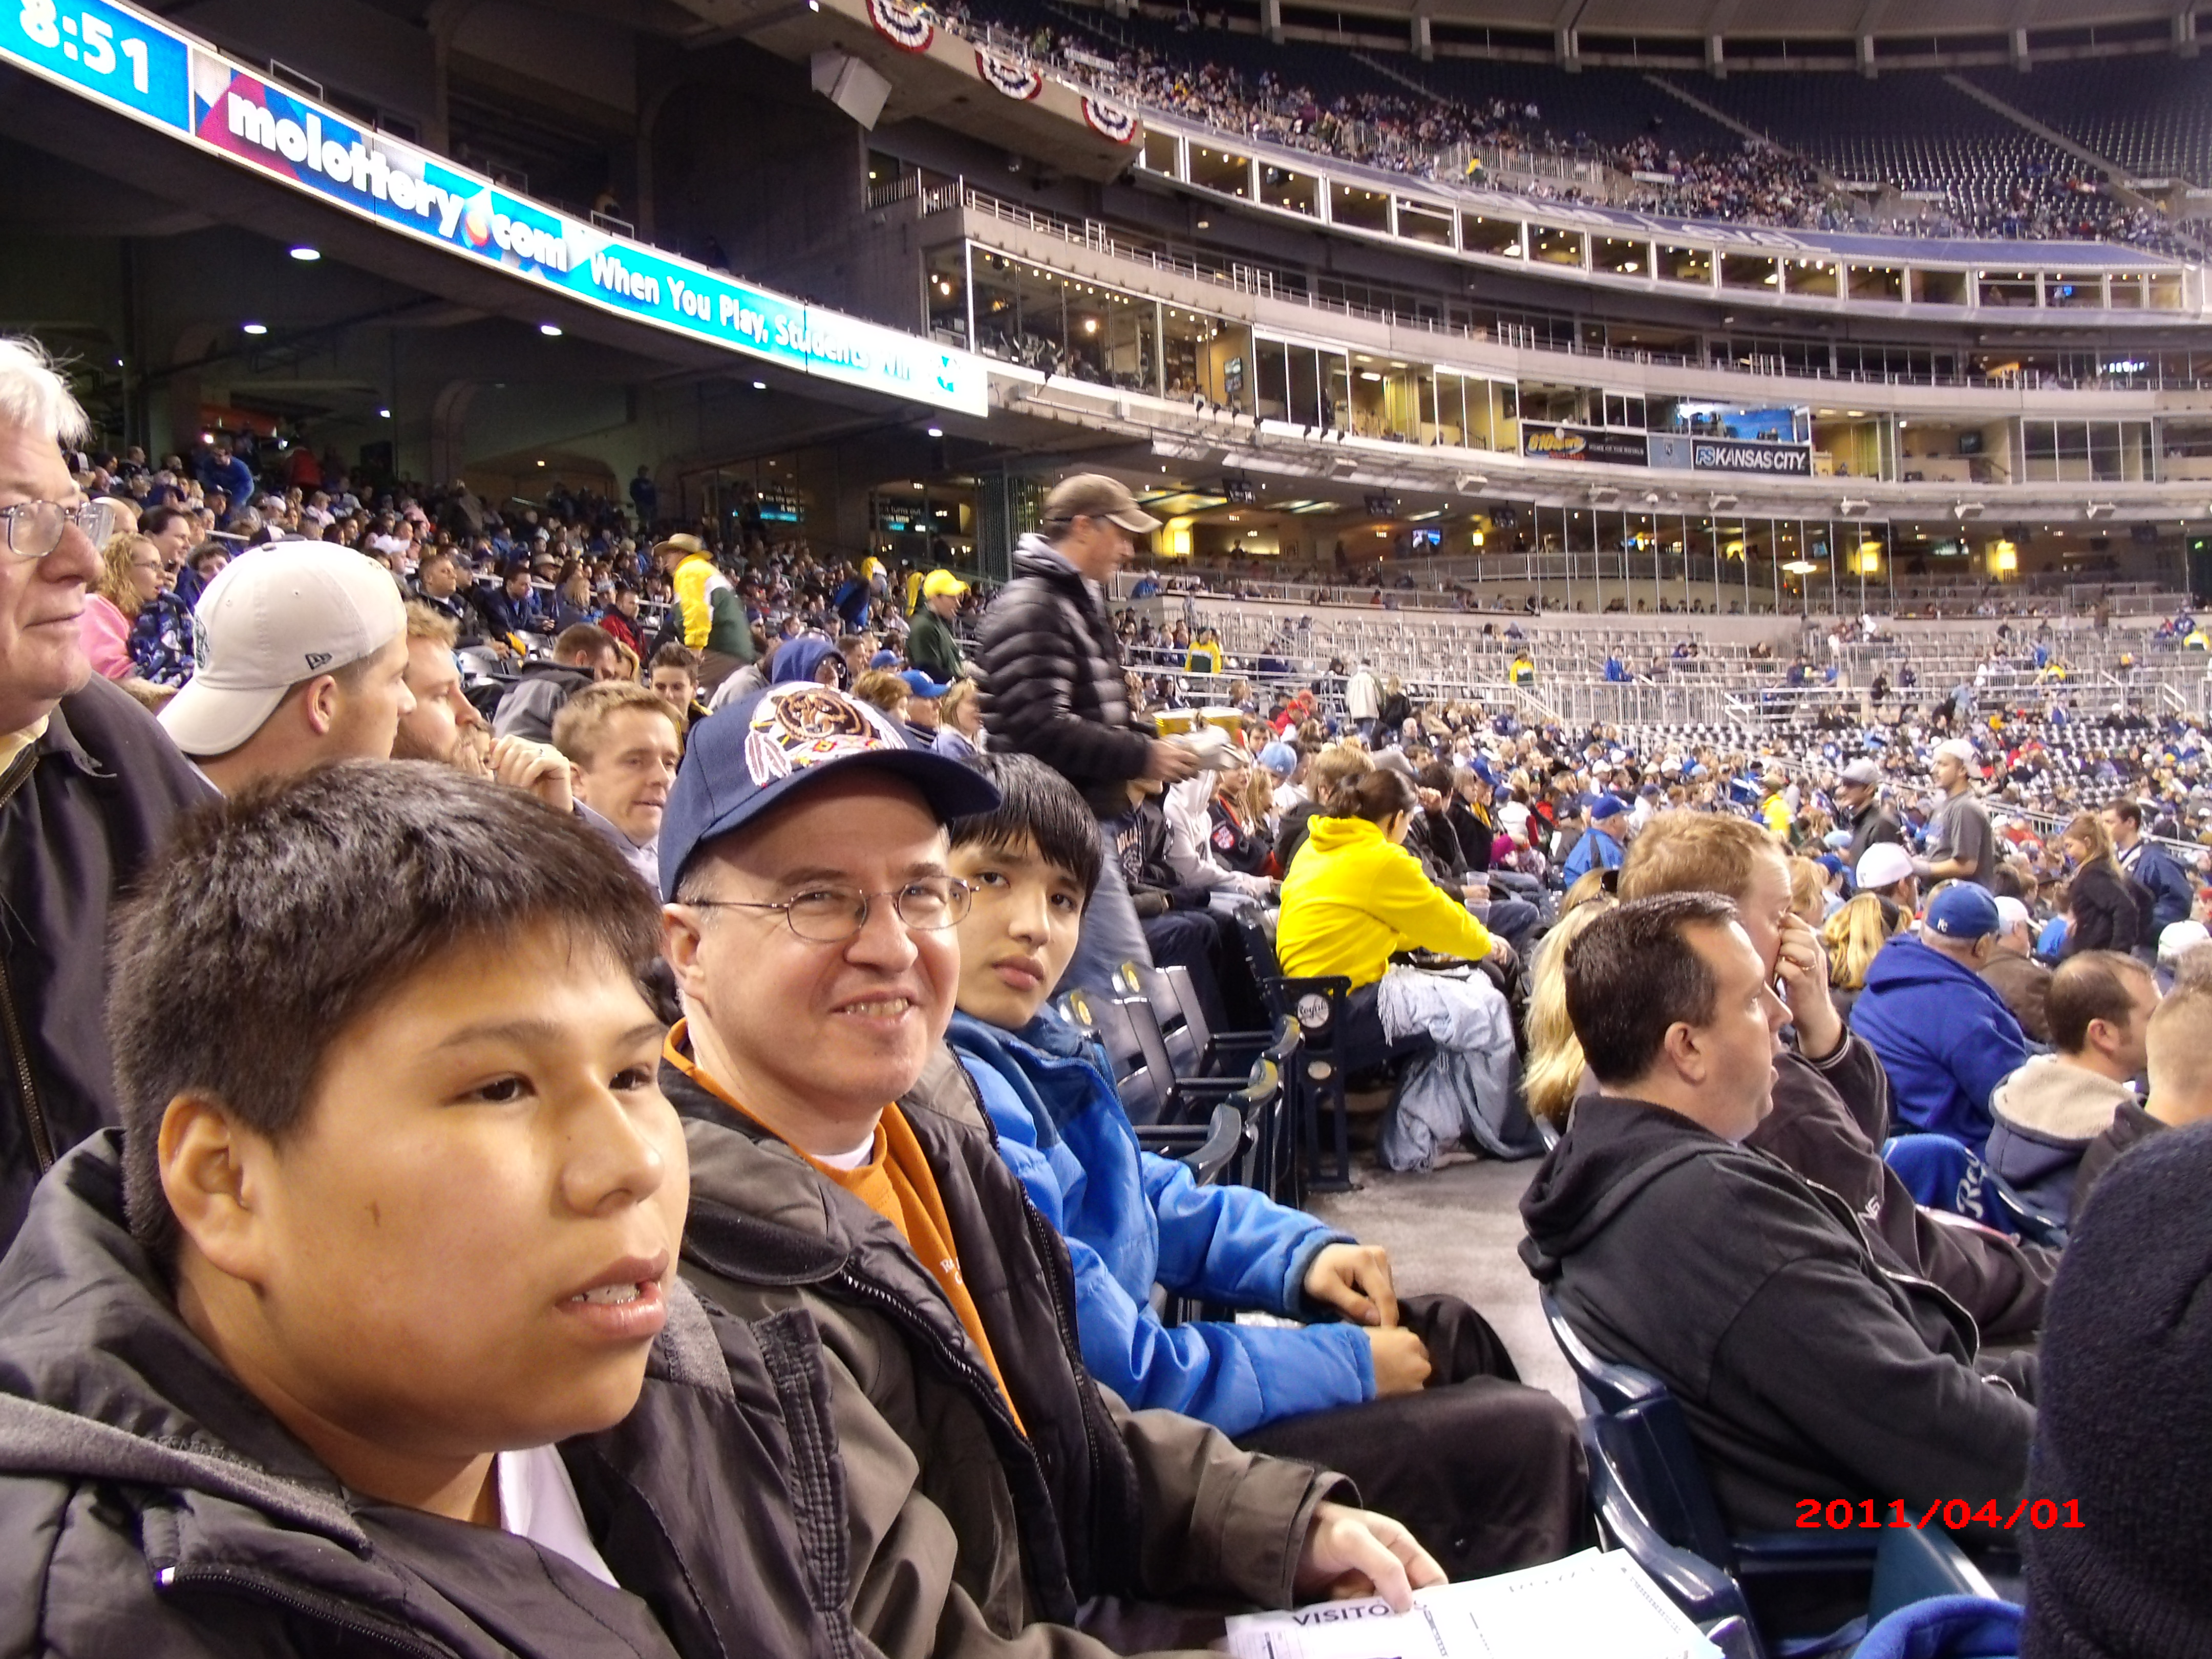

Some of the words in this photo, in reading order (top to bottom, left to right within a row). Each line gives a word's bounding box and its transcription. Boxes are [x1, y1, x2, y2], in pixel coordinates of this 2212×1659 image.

[19, 0, 149, 94] 8:51
[589, 251, 662, 305] When
[666, 276, 712, 321] You
[718, 293, 769, 344] Play,
[775, 314, 870, 370] Students
[1292, 1603, 1391, 1626] VISITO
